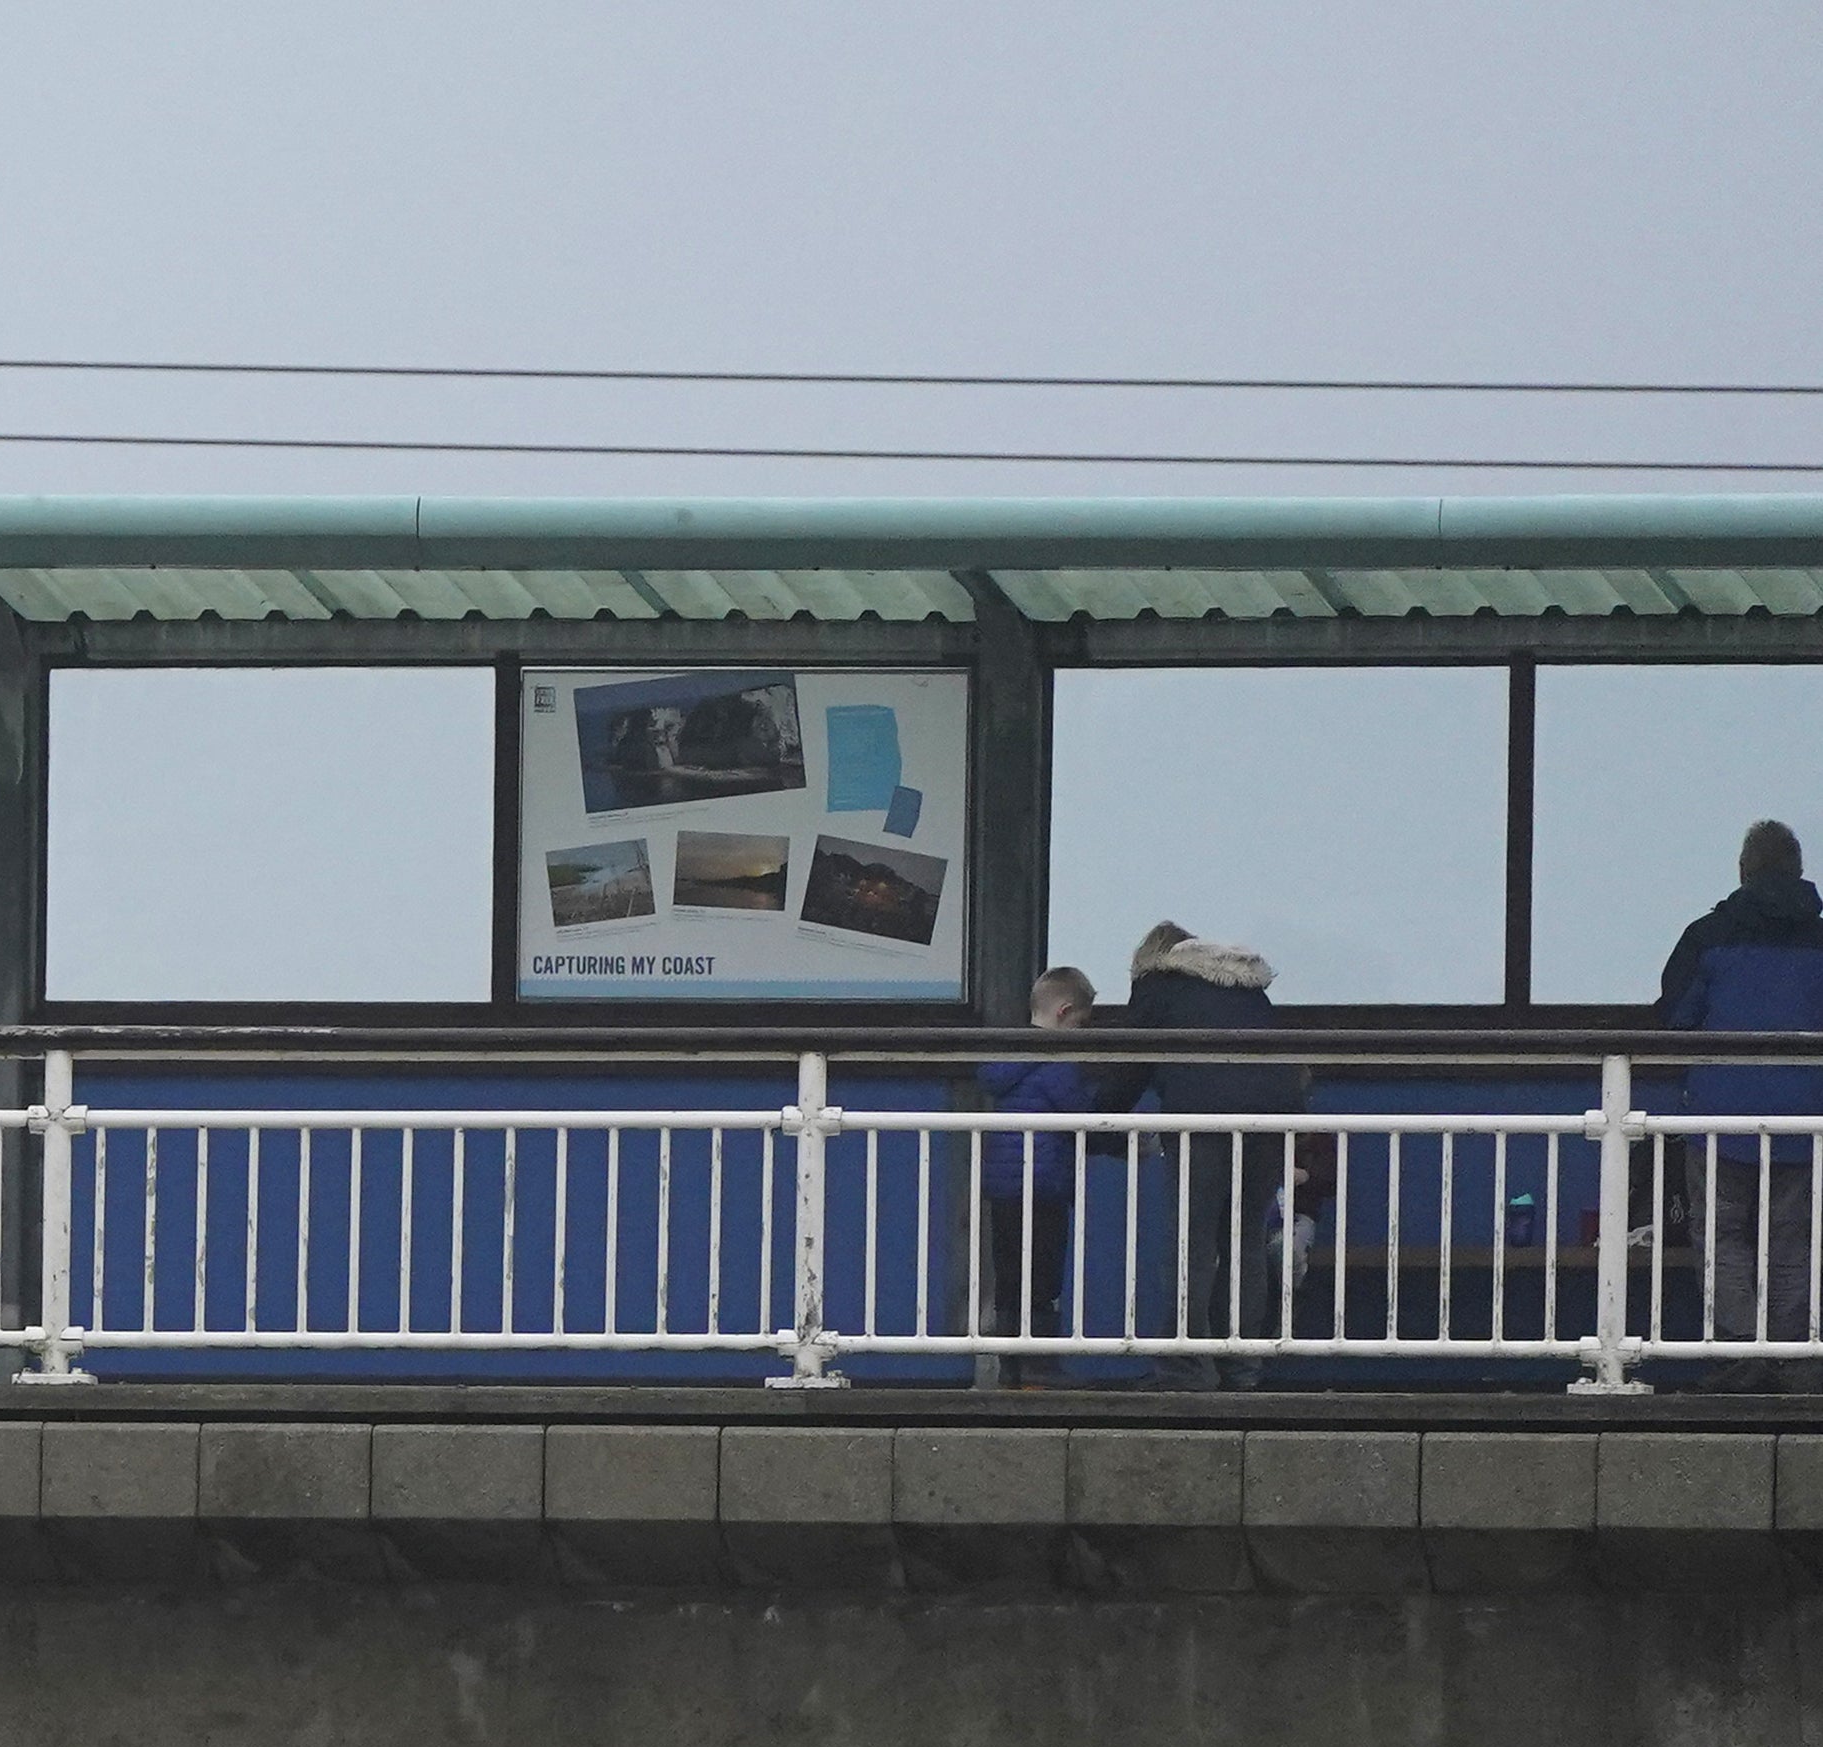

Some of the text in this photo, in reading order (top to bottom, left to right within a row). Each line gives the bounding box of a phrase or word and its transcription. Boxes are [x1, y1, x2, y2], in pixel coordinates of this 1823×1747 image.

[533, 955, 715, 976] CAPTURING MY COAST
